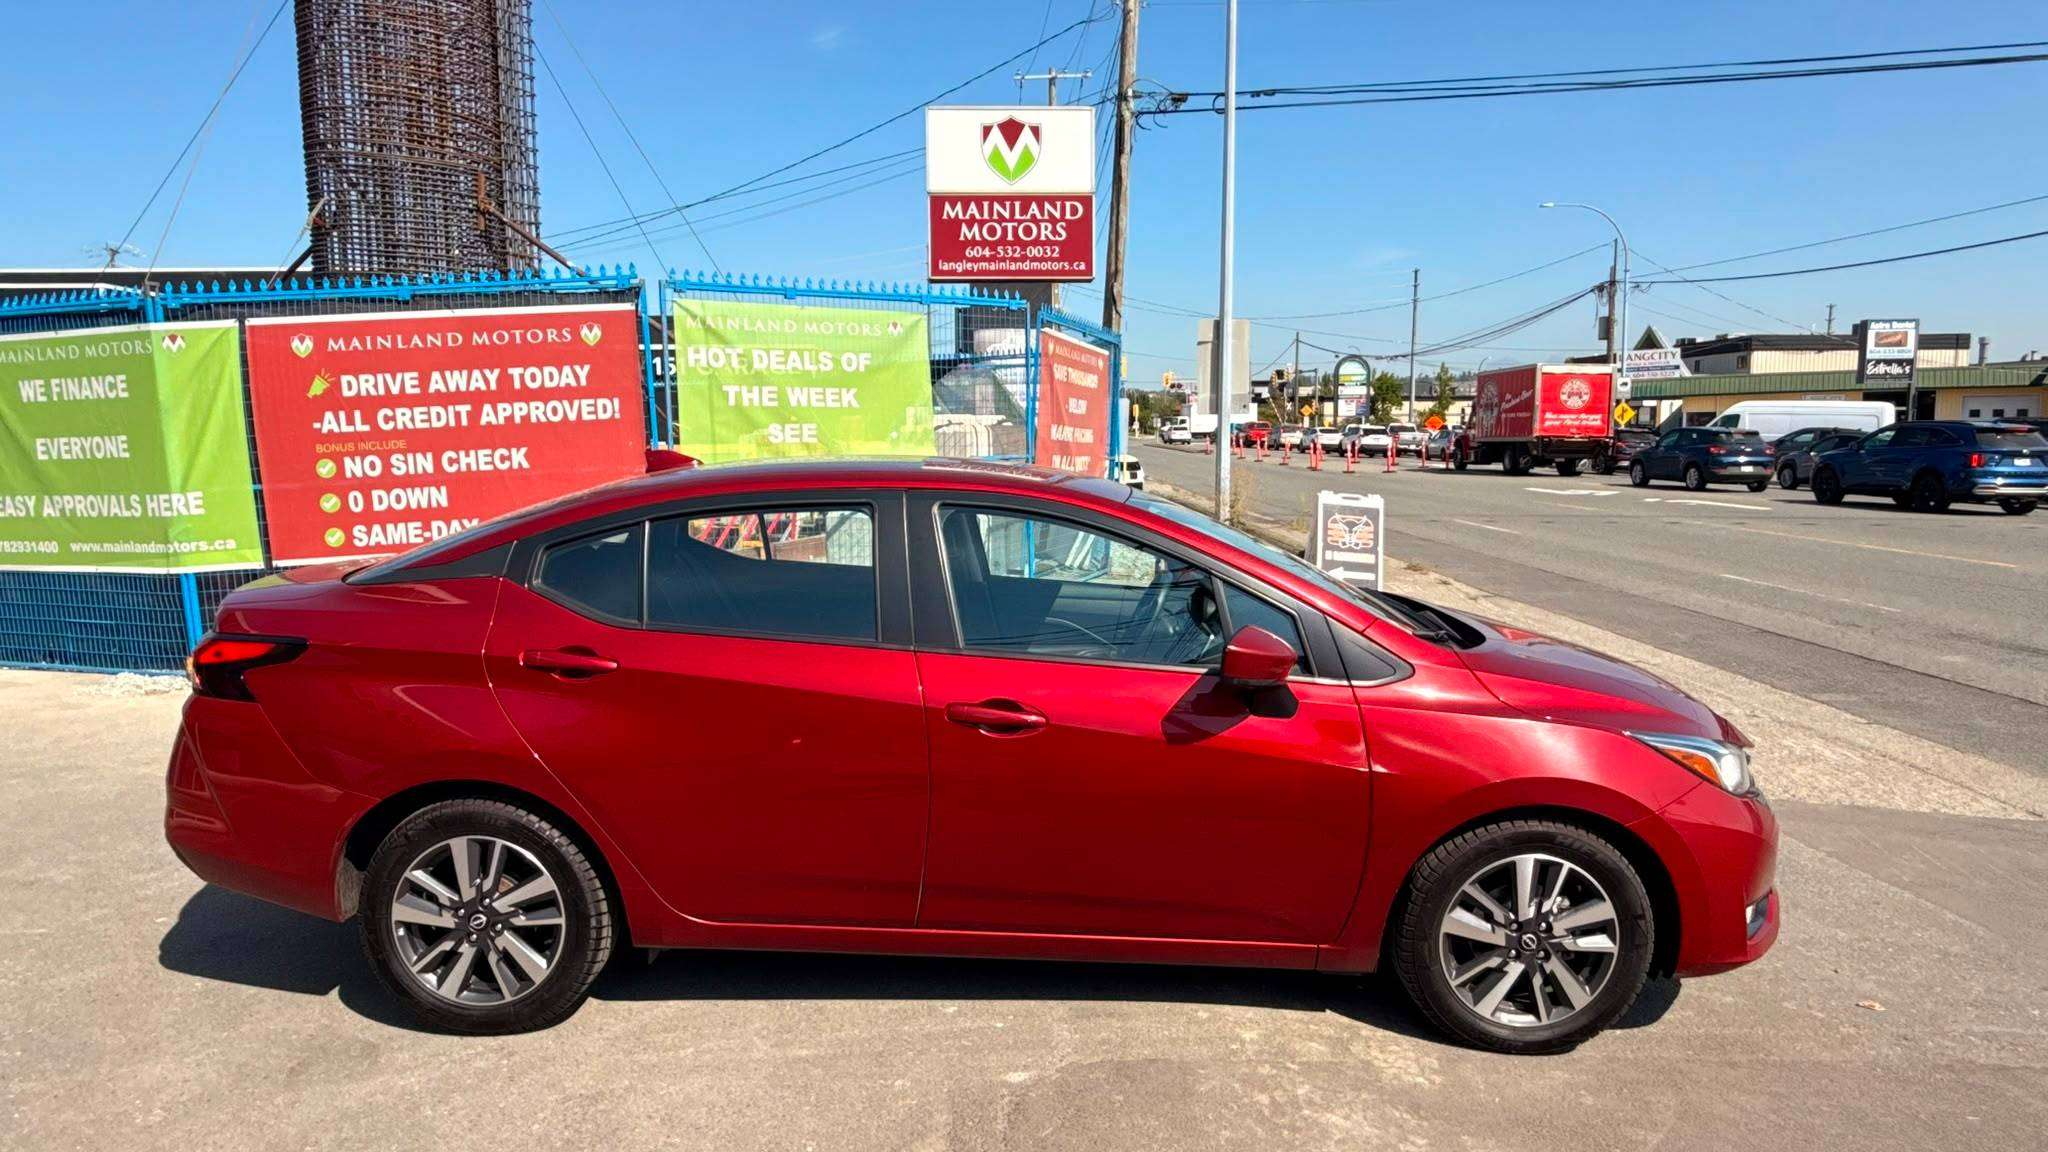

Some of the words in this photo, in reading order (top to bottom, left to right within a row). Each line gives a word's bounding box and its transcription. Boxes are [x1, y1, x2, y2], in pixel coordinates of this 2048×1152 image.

[942, 200, 1084, 220] MAINLAND
[958, 221, 1067, 241] MOTORS
[965, 245, 1060, 258] 604-532-0032
[938, 259, 1086, 273] langleymainlandmotors.ca
[686, 316, 797, 334] MAINLAND
[803, 321, 883, 337] MOTORS
[84, 339, 152, 356] MOTORS
[326, 332, 463, 352] MAINLAND
[471, 327, 573, 346] MOTORS
[687, 346, 744, 369] HOT
[751, 348, 834, 373] DEALS
[840, 352, 873, 372] OF
[1866, 360, 1911, 375] Estrella's
[18, 378, 48, 403] WE
[50, 374, 129, 402] FINANCE
[340, 372, 421, 397] DRIVE
[427, 368, 500, 394] AWAY
[507, 364, 591, 389] TODAY
[722, 385, 779, 407] THE
[785, 386, 861, 409] WEEK
[312, 409, 371, 434] -ALL
[376, 405, 472, 431] CREDIT
[479, 397, 621, 426] APPROVED!
[767, 423, 819, 444] SEE
[35, 434, 130, 461] EVERYONE
[315, 443, 356, 454] BONUS
[357, 440, 408, 452] INCLUDE
[343, 455, 384, 478] NO
[390, 452, 434, 475] SIN
[441, 447, 531, 473] CHECK
[42, 493, 142, 518] APPROVALS
[146, 491, 206, 517] HERE
[347, 491, 365, 513] 0
[371, 486, 449, 512] DOWN
[69, 538, 237, 554] www.mainlandmotors.ca
